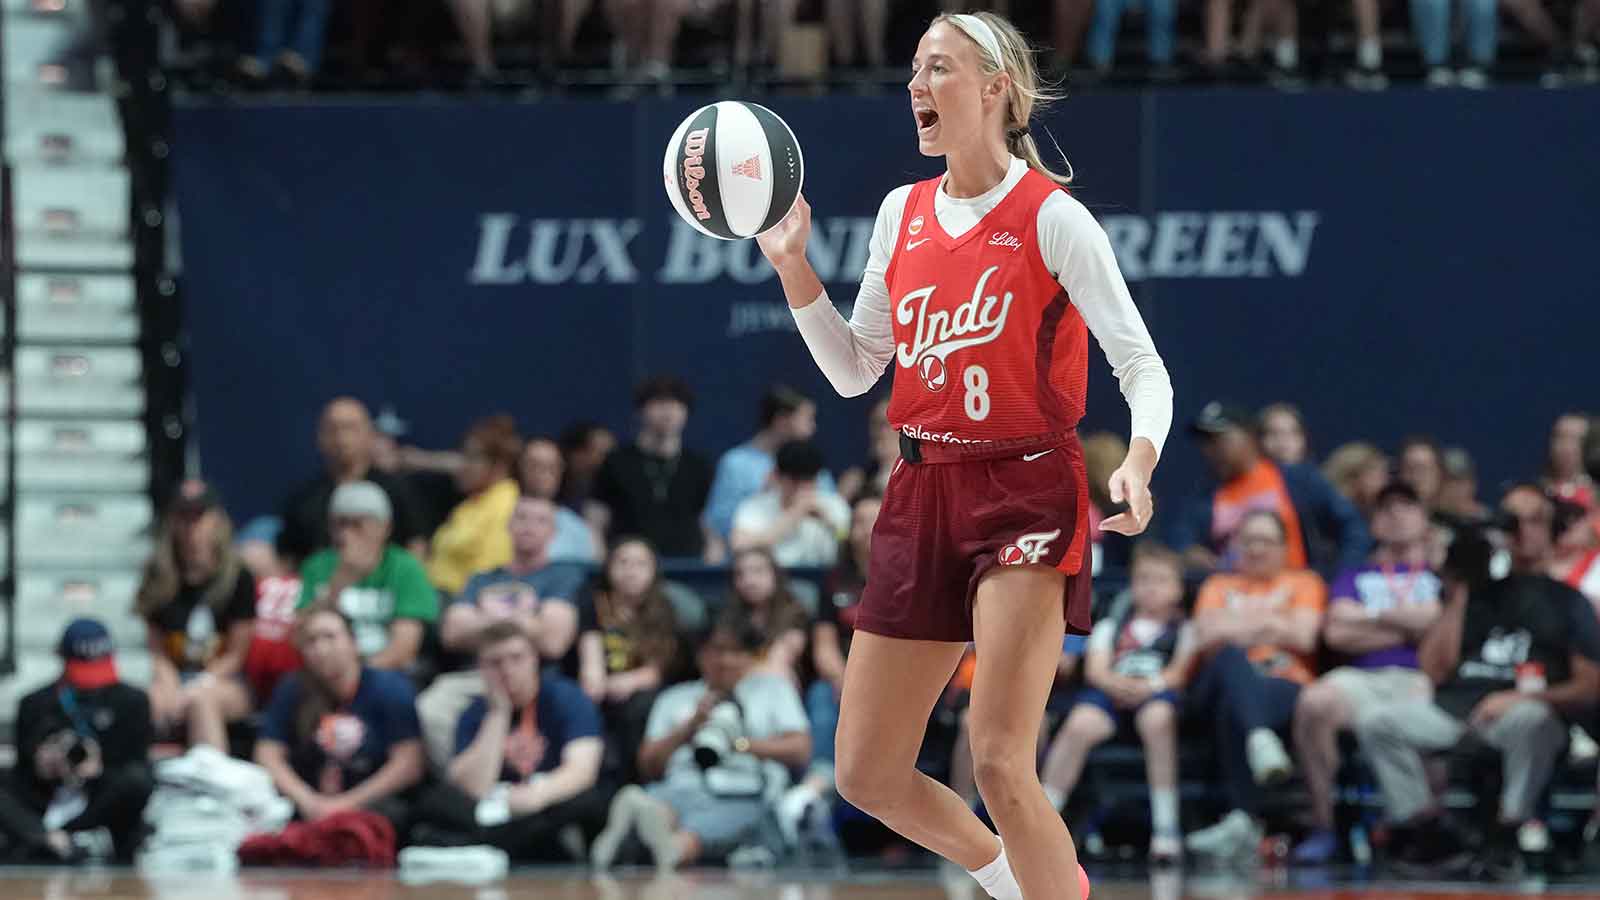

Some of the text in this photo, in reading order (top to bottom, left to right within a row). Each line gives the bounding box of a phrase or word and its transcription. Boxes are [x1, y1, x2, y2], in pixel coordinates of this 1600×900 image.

[684, 127, 712, 221] Wilson
[468, 212, 641, 284] LUX
[1101, 209, 1321, 280] REEN
[988, 231, 1023, 252] Lilly
[896, 265, 1013, 368] Indy
[963, 364, 990, 421] 8
